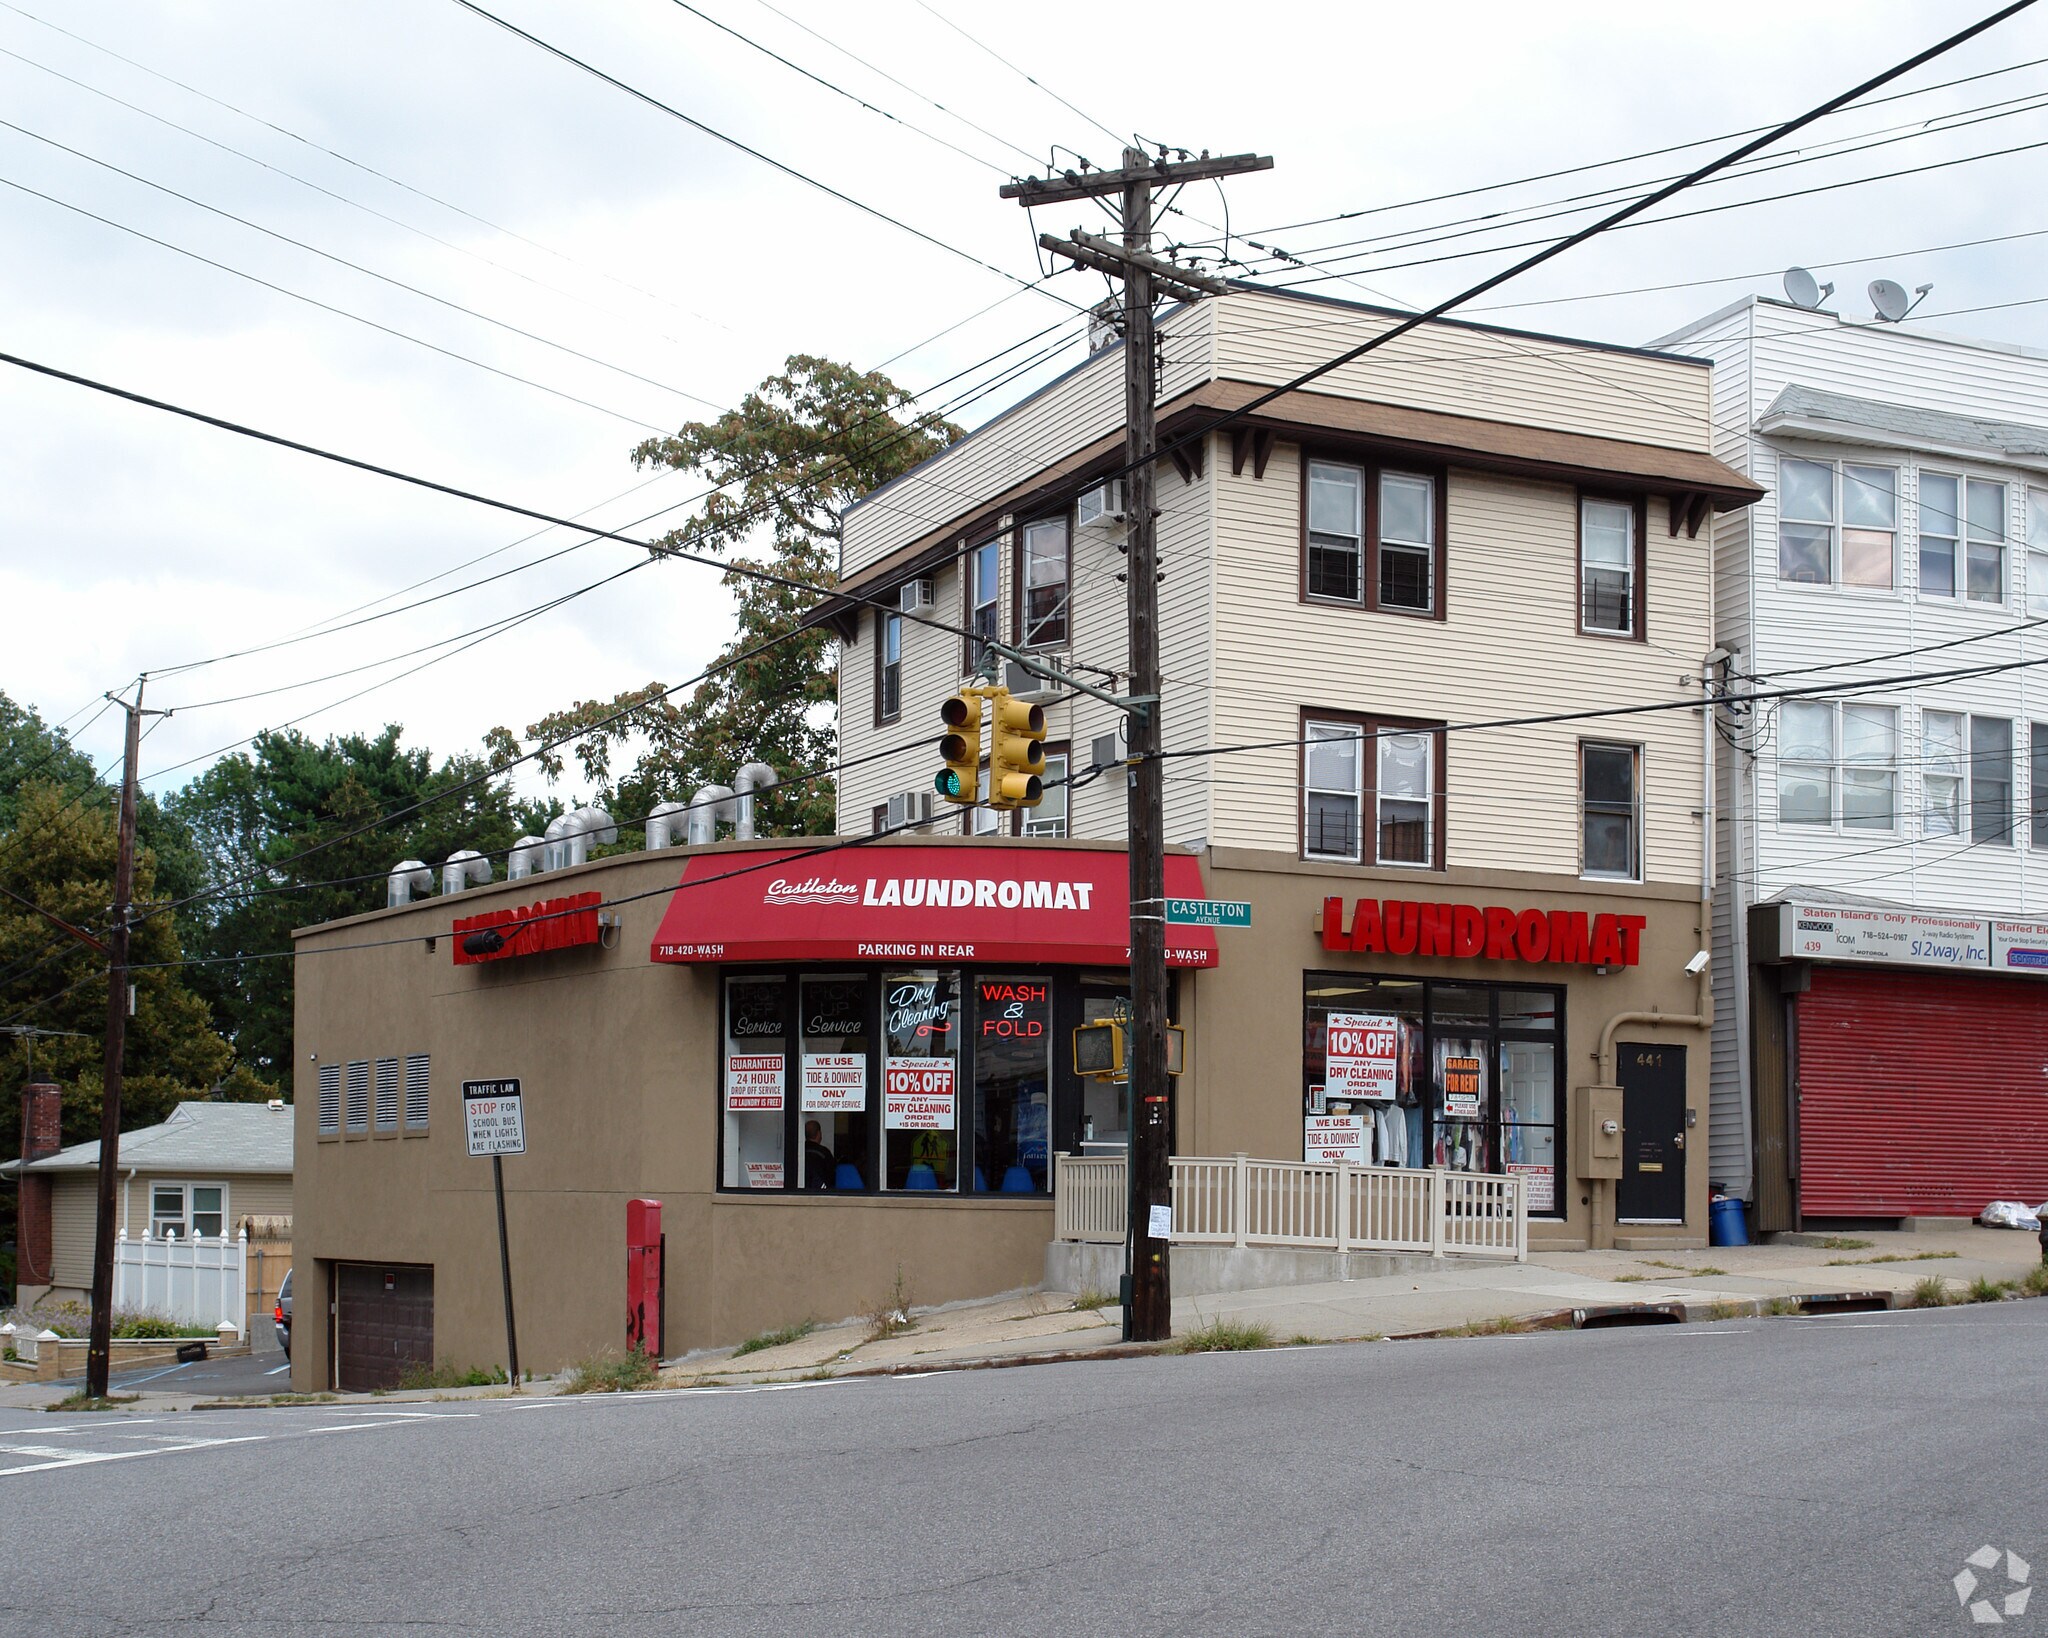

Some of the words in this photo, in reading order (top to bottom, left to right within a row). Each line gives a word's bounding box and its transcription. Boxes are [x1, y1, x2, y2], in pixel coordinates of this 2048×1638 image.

[767, 878, 858, 896] Castleton
[862, 879, 1093, 910] LAUNDROMAT
[1172, 901, 1244, 917] CASTLETON
[1195, 916, 1221, 924] AVENUE
[1803, 908, 1836, 918] Staten
[1841, 909, 1878, 920] Island's
[1884, 913, 1906, 924] Only
[1911, 915, 1981, 931] Professionally
[1322, 897, 1646, 966] LAUNDROMAT
[1798, 921, 1833, 932] KENWOOD
[1996, 922, 2033, 934] Staffed
[1922, 930, 1938, 939] 2-way
[1939, 931, 1953, 939] Radio
[1954, 932, 1974, 941] Systems
[1998, 935, 2008, 943] Your
[659, 944, 724, 956] 718-420-WASH
[858, 943, 916, 956] PARKING
[921, 944, 934, 956] IN
[938, 944, 974, 957] REAR
[1804, 941, 1821, 952] 439
[1911, 941, 1922, 956] SI
[1924, 941, 1962, 962] 2way,
[1966, 944, 1987, 961] Inc.
[1125, 948, 1207, 961] 70-WASH
[890, 984, 936, 1007] Dry
[982, 984, 1046, 1002] WASH
[1003, 1002, 1024, 1019] &
[889, 1001, 949, 1033] Cleaning
[1343, 1016, 1383, 1028] Special
[734, 1016, 782, 1035] Service
[807, 1015, 861, 1034] Service
[983, 1020, 1043, 1037] FOLD
[1331, 1031, 1364, 1055] 10%
[1366, 1032, 1394, 1056] OFF
[731, 1058, 781, 1070] GUARANTEED
[815, 1057, 831, 1066] WE
[834, 1057, 853, 1066] USE
[901, 1059, 939, 1069] Special
[1447, 1058, 1478, 1070] GARAGE
[1637, 1053, 1662, 1067] 441
[737, 1073, 748, 1085] 24
[751, 1073, 776, 1085] HOUR
[806, 1071, 822, 1084] TIDE
[823, 1071, 829, 1084] &
[831, 1071, 862, 1084] DOWNEY
[1330, 1067, 1348, 1078] DRY
[1350, 1067, 1393, 1080] CLEANING
[888, 1072, 920, 1093] 10%
[922, 1072, 951, 1093] OFF
[1347, 1080, 1378, 1088] ORDER
[1446, 1073, 1459, 1092] FOR
[1460, 1074, 1478, 1093] RENT
[469, 1084, 497, 1095] TRAFFIC
[500, 1083, 514, 1093] LAW
[731, 1086, 746, 1095] DROP
[747, 1086, 757, 1095] OFF
[758, 1086, 781, 1095] SERVICE
[822, 1089, 846, 1098] ONLY
[470, 1102, 497, 1115] STOP
[500, 1102, 516, 1112] FOR
[806, 1100, 816, 1109] FOR
[841, 1100, 861, 1109] SERVICE
[888, 1103, 905, 1113] DRY
[907, 1103, 951, 1114] CLEANING
[473, 1117, 499, 1128] SCHOOL
[503, 1116, 516, 1126] BUS
[1315, 1119, 1330, 1127] WE
[1333, 1119, 1351, 1127] USE
[473, 1129, 491, 1139] WHEN
[495, 1128, 518, 1138] LIGHTS
[1307, 1133, 1322, 1145] TIDE
[1323, 1133, 1329, 1144] &
[1331, 1132, 1360, 1145] DOWNEY
[472, 1141, 485, 1151] ARE
[489, 1139, 521, 1150] FLASHING
[1322, 1150, 1345, 1159] ONLY
